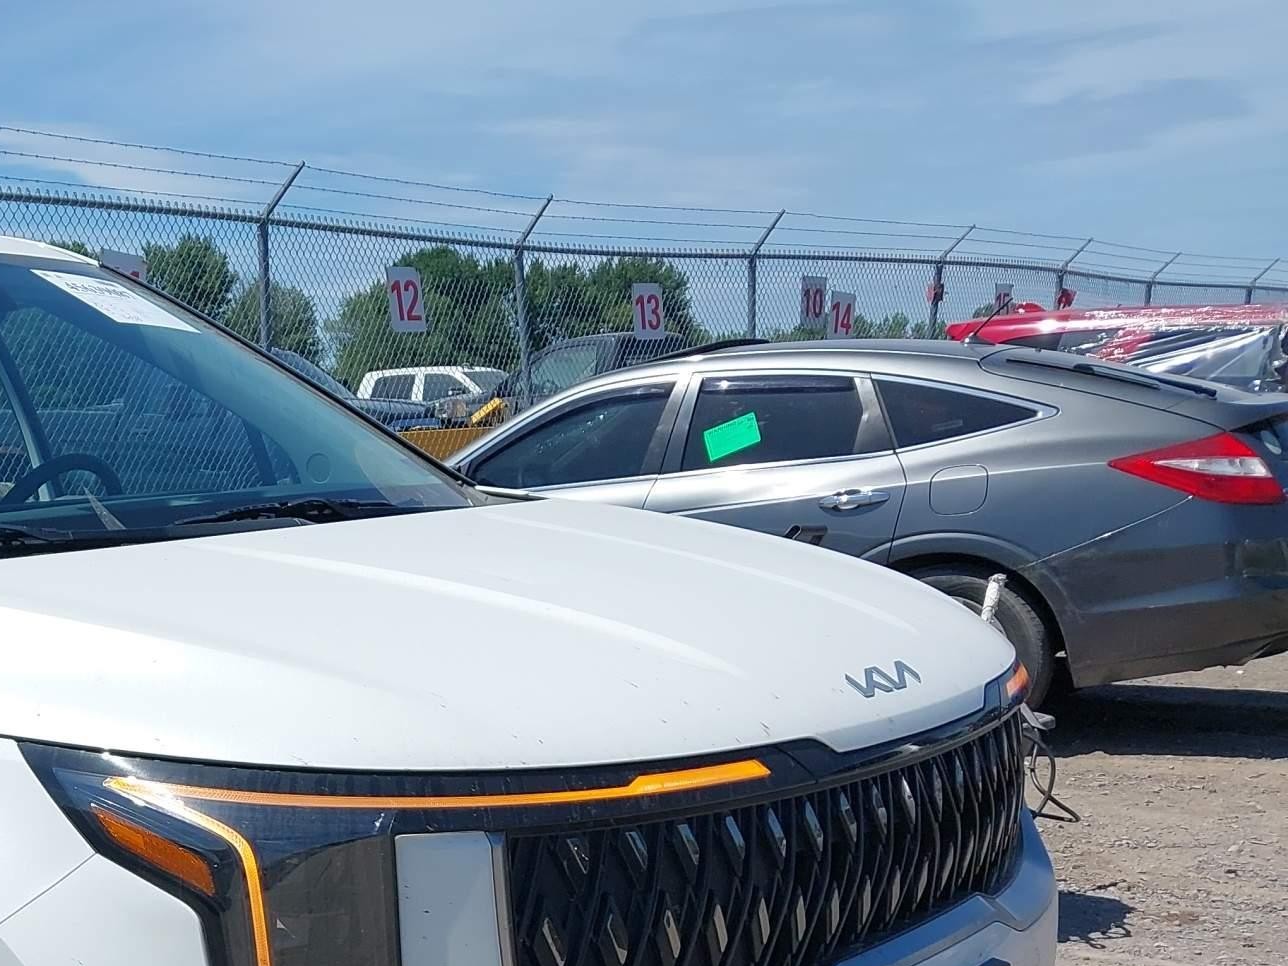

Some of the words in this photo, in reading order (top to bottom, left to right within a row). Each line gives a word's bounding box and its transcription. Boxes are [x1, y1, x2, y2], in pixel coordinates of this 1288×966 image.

[391, 279, 423, 321] 12
[635, 294, 661, 330] 13
[803, 287, 824, 318] 10
[832, 301, 852, 336] 14
